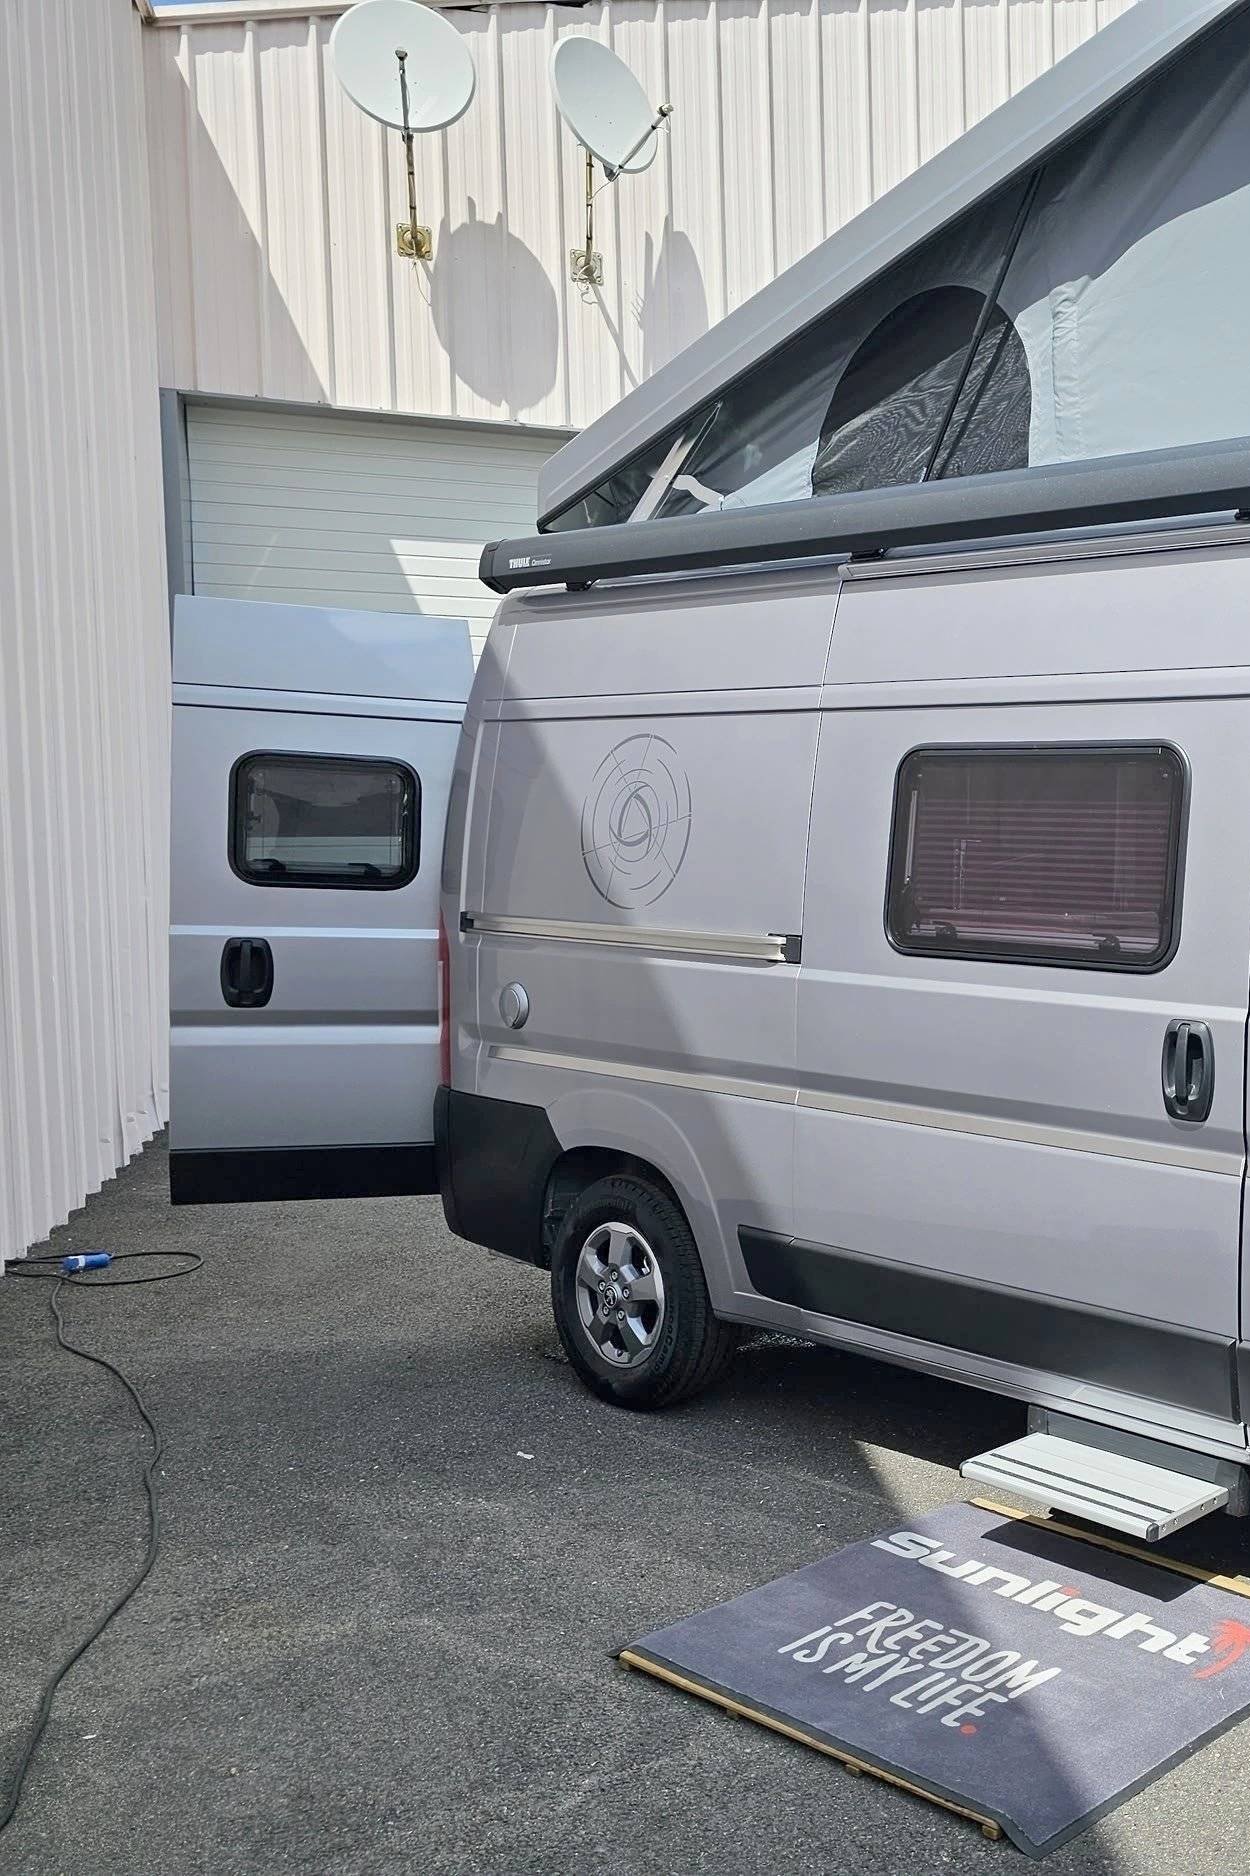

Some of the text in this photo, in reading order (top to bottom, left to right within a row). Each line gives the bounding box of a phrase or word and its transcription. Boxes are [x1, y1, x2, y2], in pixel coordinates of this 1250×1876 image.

[509, 557, 531, 569] THULE
[777, 1625, 854, 1663] IS
[822, 1652, 925, 1692] MY
[833, 1601, 1062, 1699] FREEDOM
